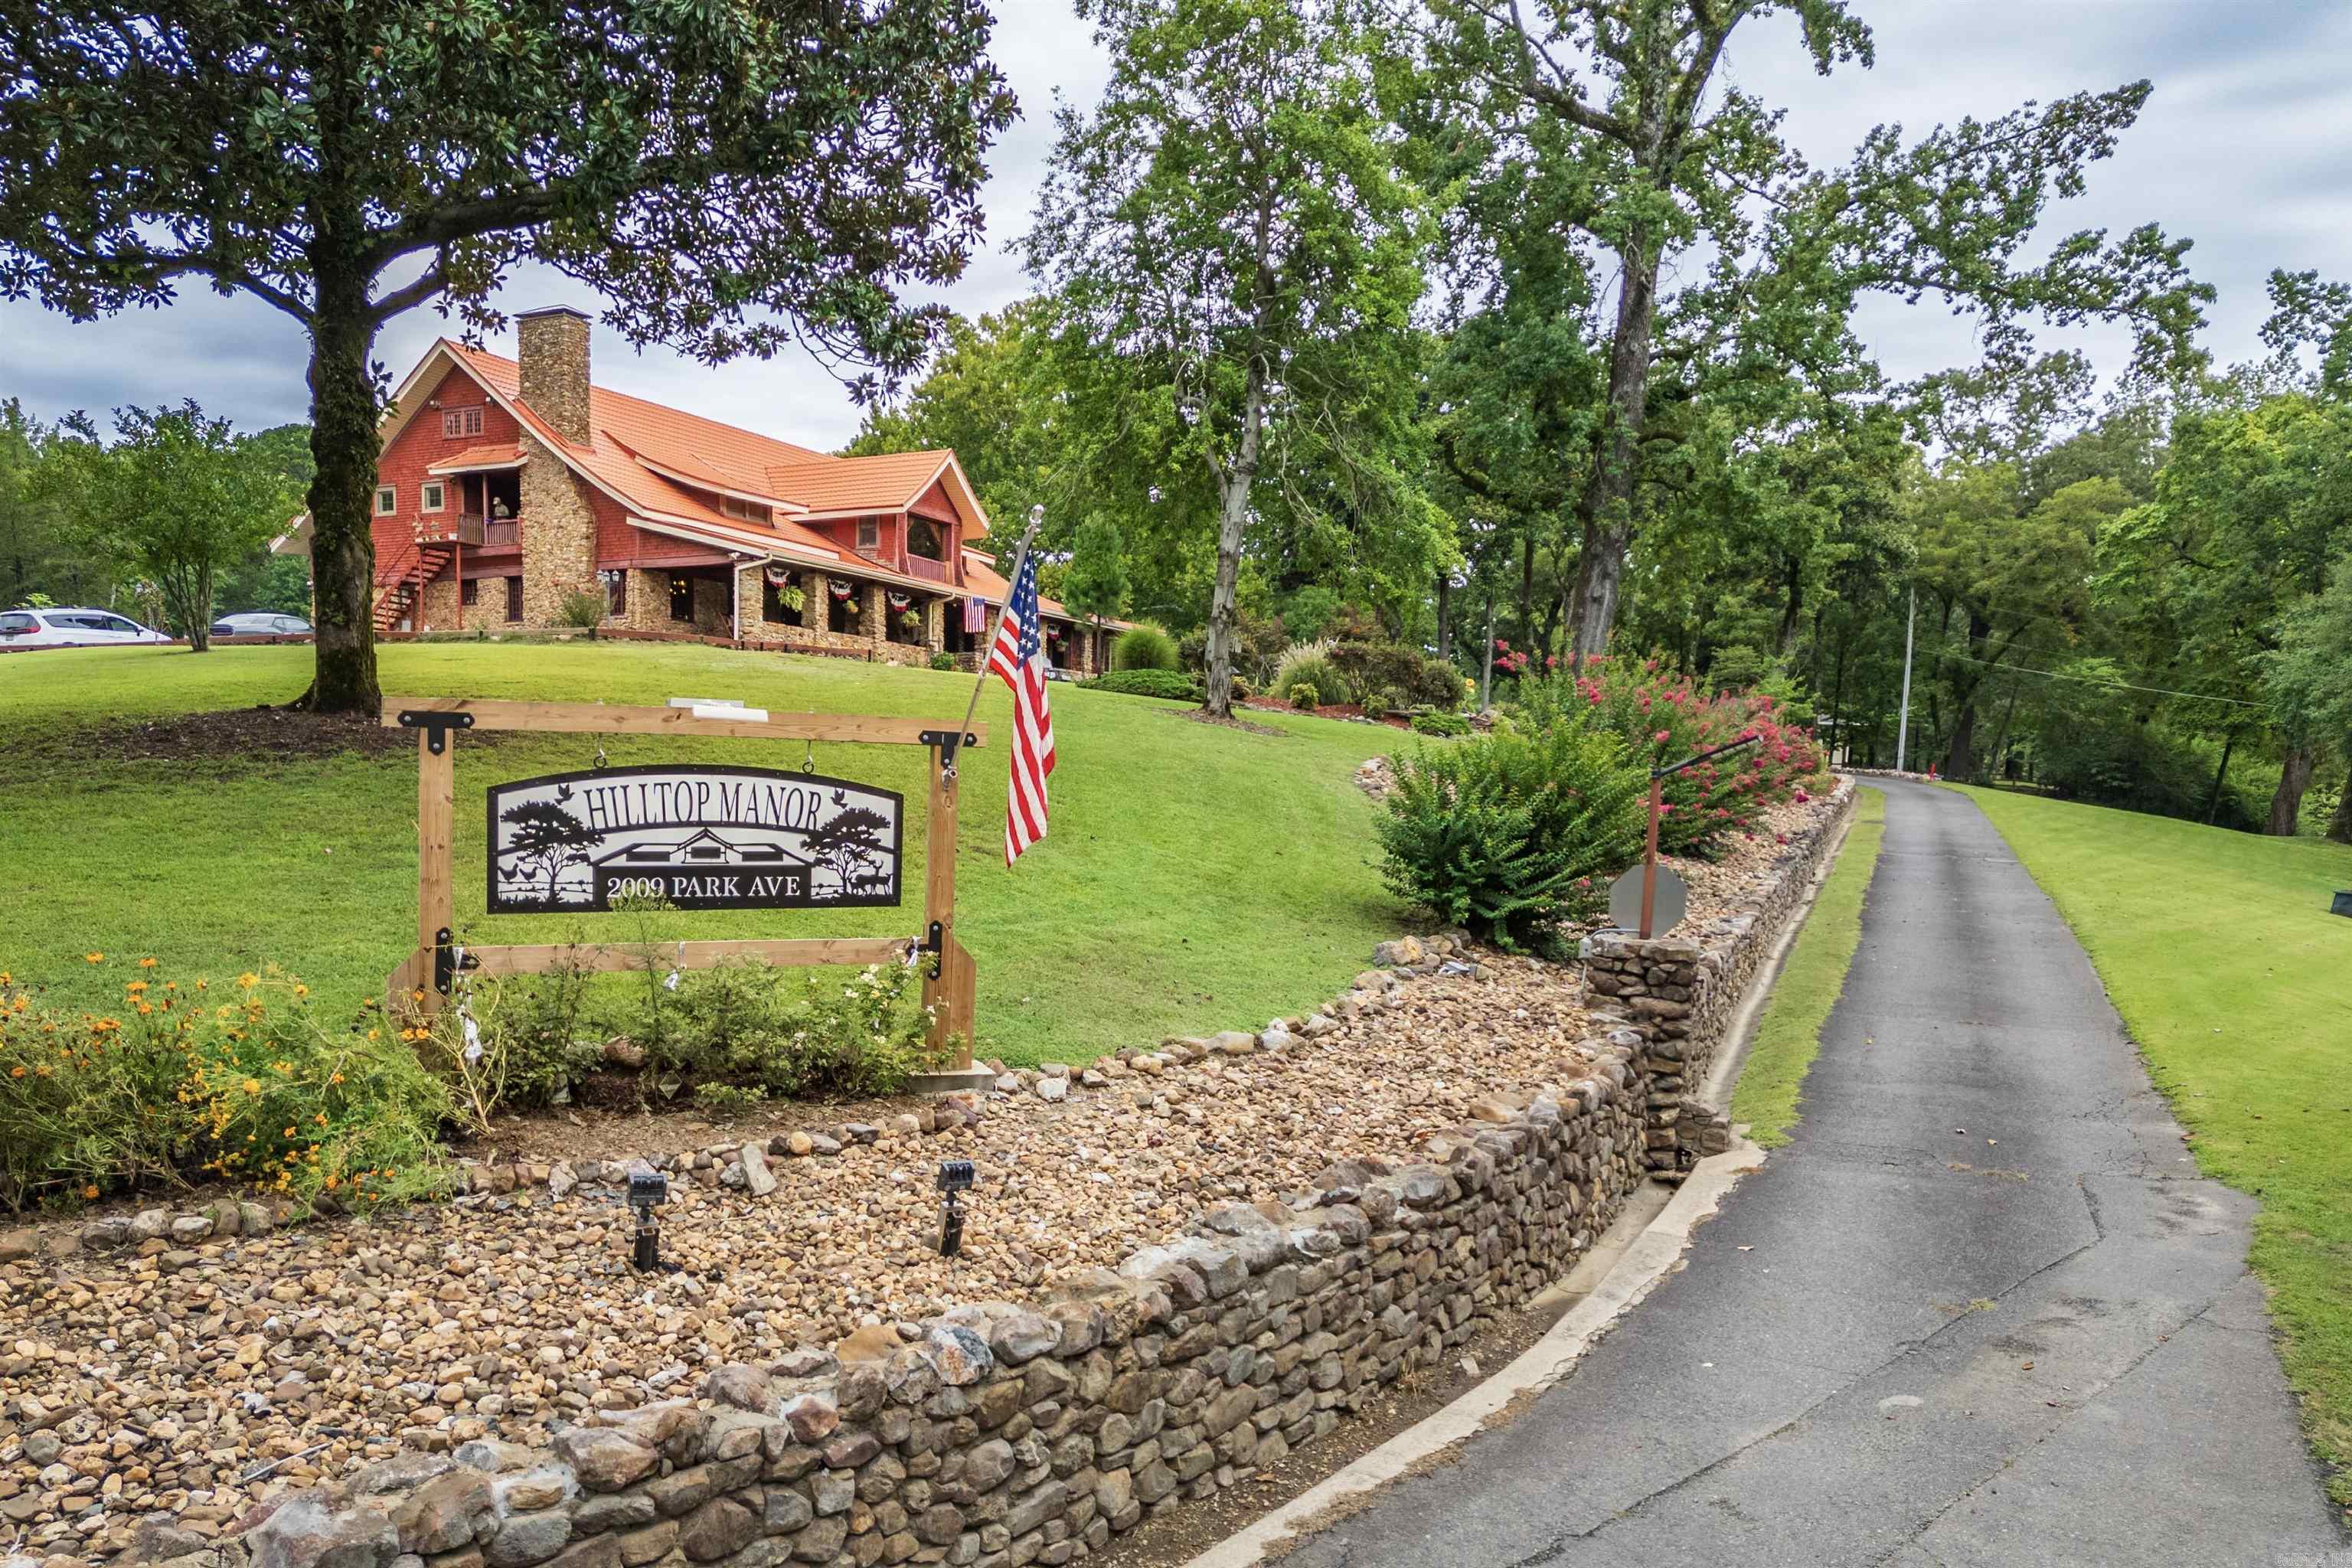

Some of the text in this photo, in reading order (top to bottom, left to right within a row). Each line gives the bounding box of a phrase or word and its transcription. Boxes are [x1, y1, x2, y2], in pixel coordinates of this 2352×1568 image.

[583, 781, 822, 830] HILLTOP MANOR
[606, 876, 800, 898] 2009 PARK AVE
